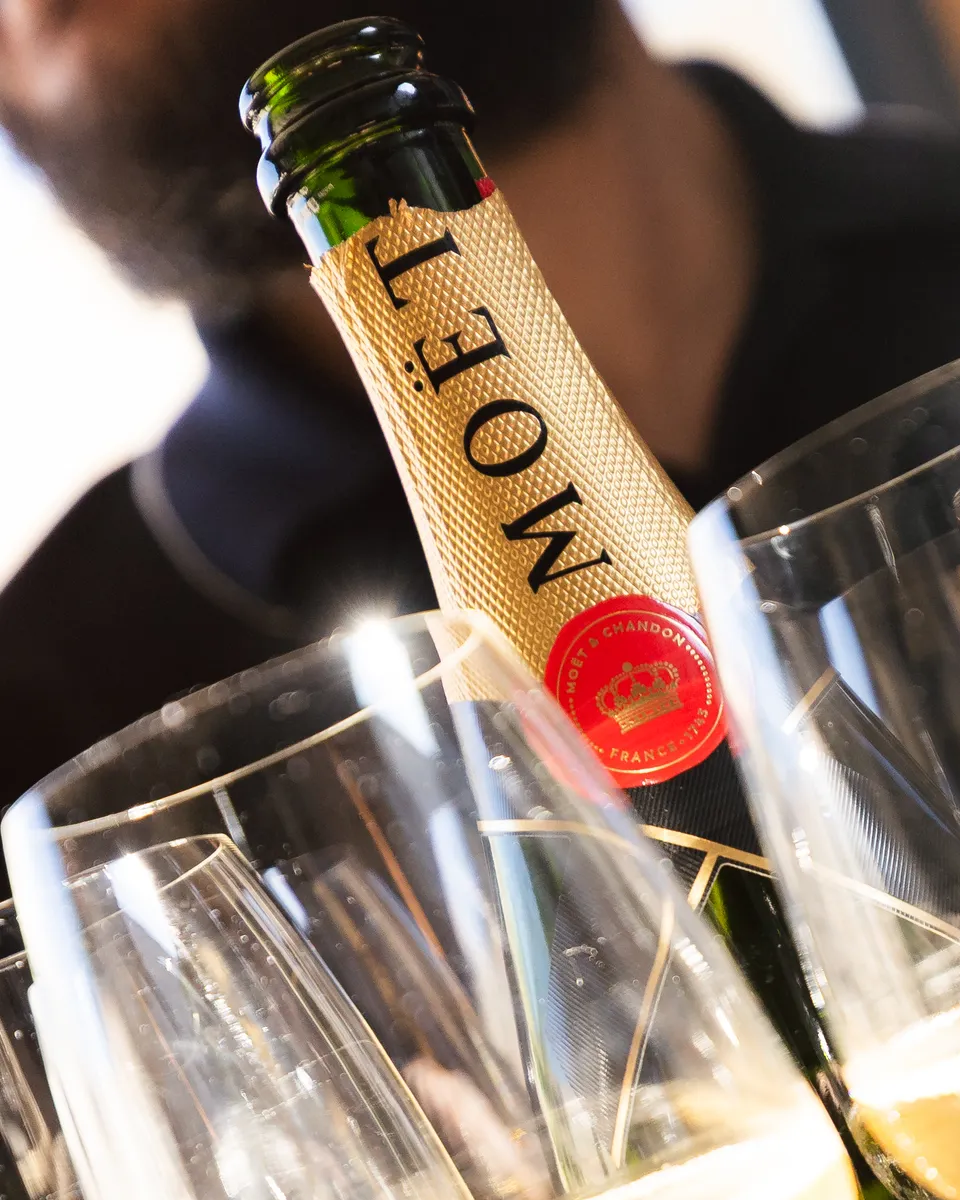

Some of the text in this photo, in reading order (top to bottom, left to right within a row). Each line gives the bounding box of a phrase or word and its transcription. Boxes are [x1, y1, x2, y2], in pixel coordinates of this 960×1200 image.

[366, 227, 612, 594] MOËT
[602, 620, 686, 647] CHANDON
[610, 740, 679, 764] FRANCE
